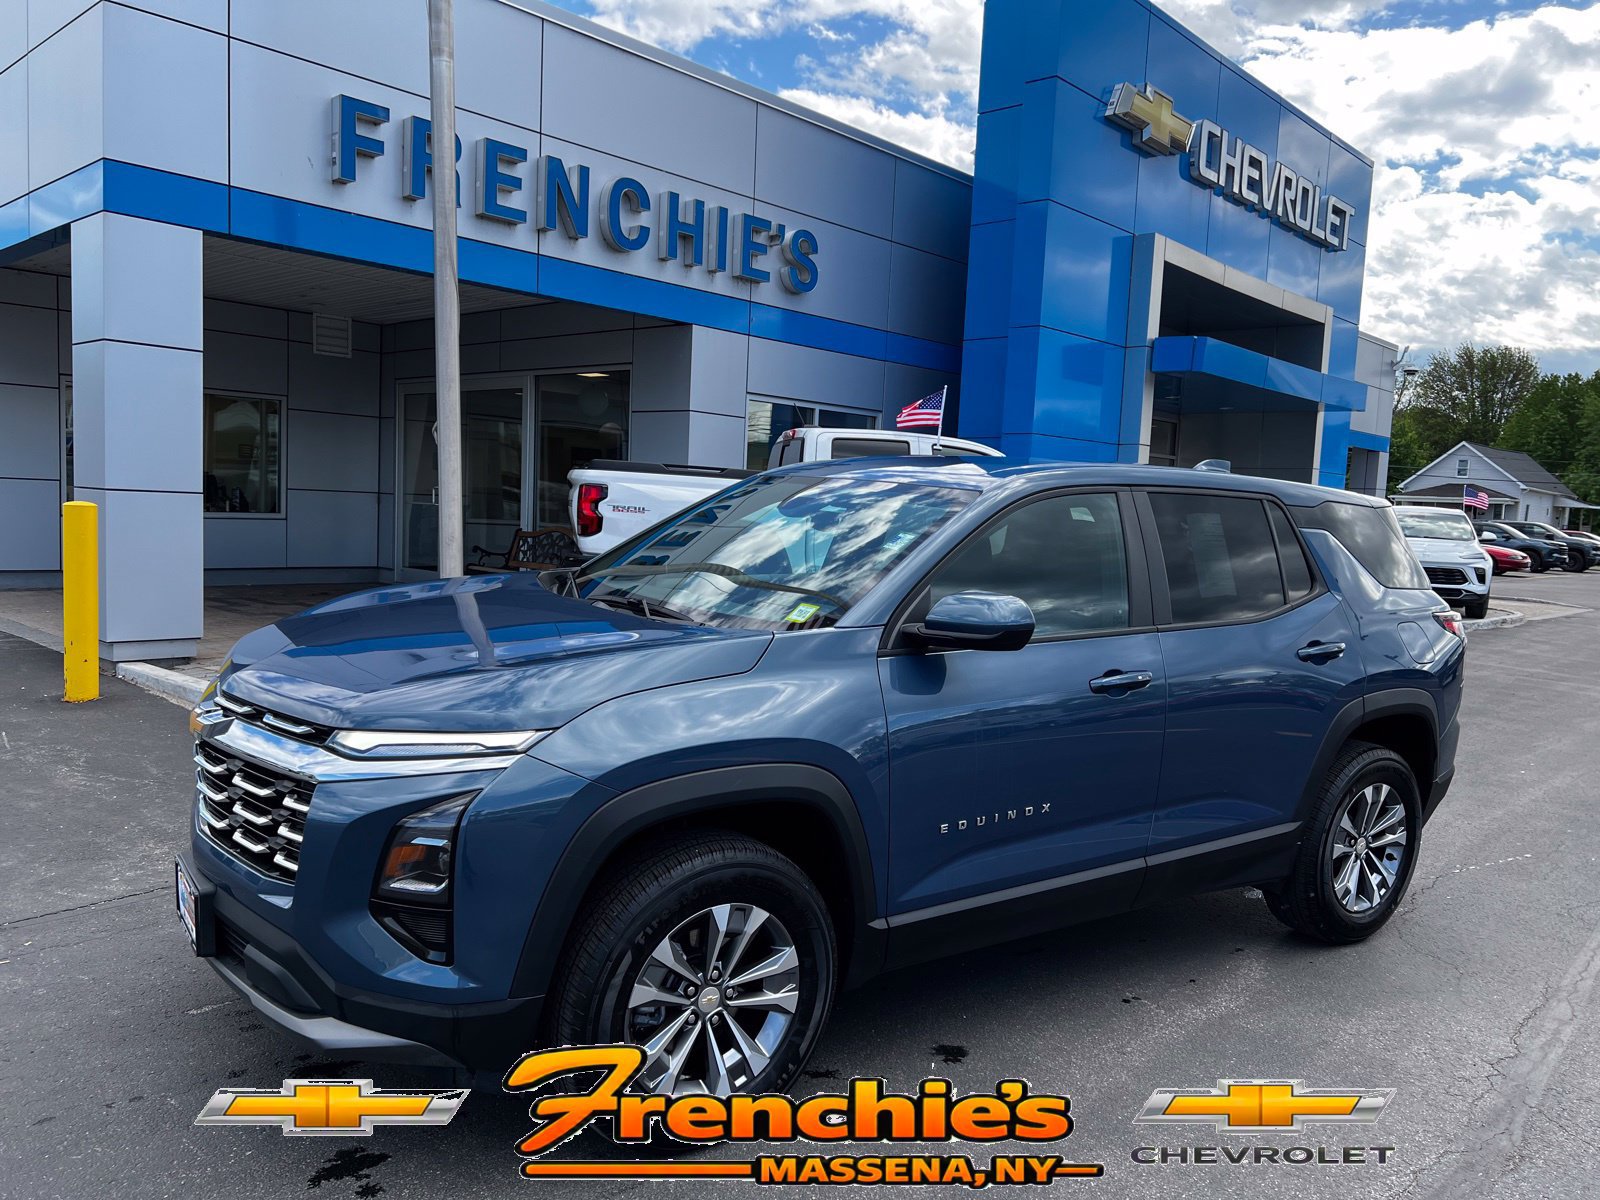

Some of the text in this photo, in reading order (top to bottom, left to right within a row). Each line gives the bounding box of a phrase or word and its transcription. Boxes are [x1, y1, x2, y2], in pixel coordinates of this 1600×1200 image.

[331, 94, 819, 295] FRENCHIE'S
[1190, 119, 1355, 252] CHEVROLET
[940, 803, 1051, 833] EQUINOX
